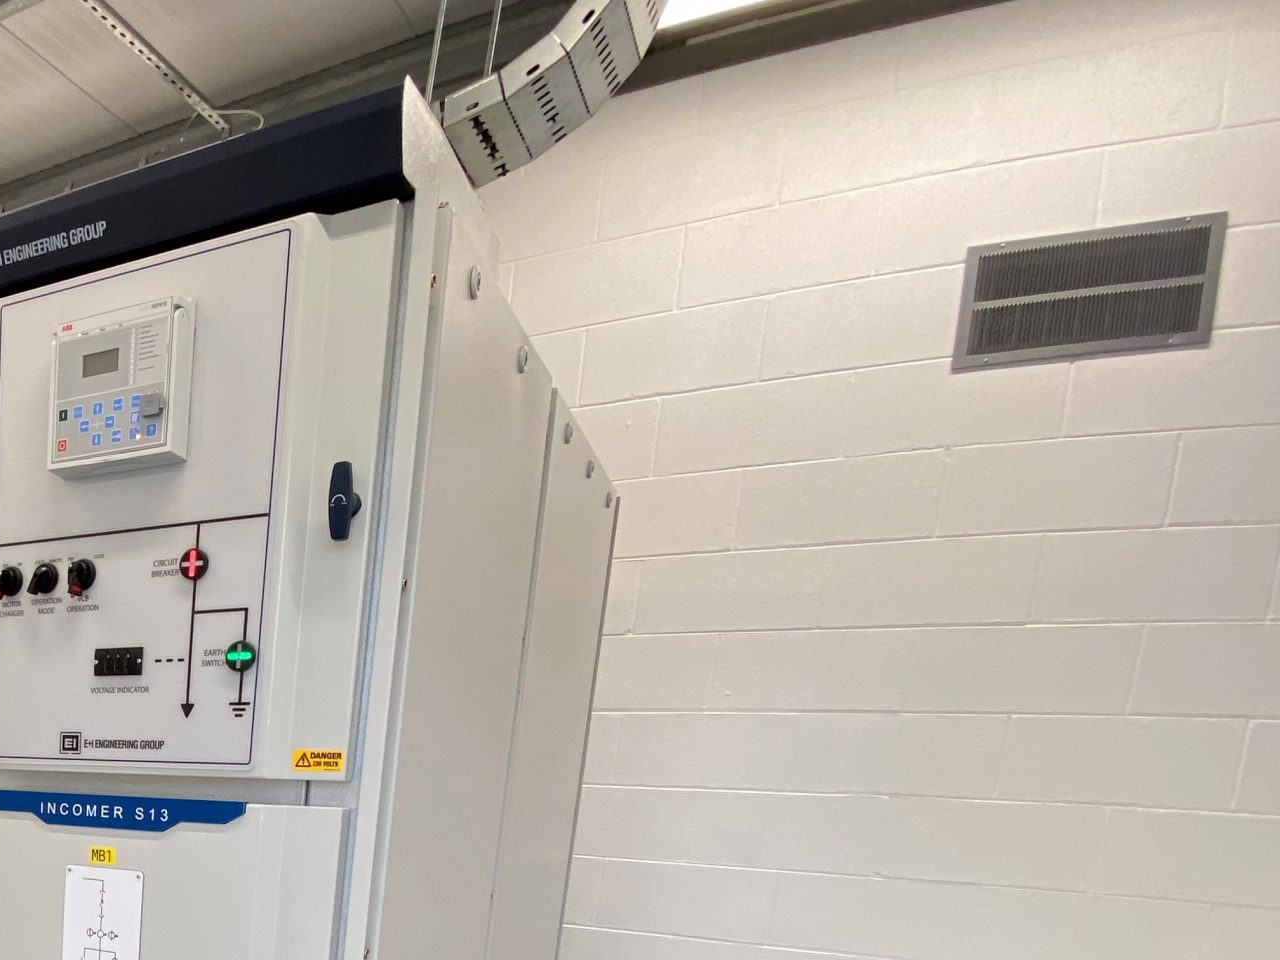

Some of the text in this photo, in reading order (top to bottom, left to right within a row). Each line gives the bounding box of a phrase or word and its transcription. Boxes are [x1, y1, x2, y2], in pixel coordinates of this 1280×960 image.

[4, 232, 68, 265] ENGINEERING
[69, 220, 107, 245] GROUP
[153, 558, 178, 567] CIRCUIT
[151, 569, 180, 578] BREAKER
[2, 600, 22, 608] MOTOR
[31, 597, 62, 606] OPERATION
[38, 607, 55, 615] MODE
[66, 604, 99, 613] OPERATION
[0, 609, 24, 618] CHARGER
[90, 686, 150, 694] VOLTAGE INDICATOR
[95, 739, 139, 750] ENGINEERING
[140, 740, 165, 750] GROUP
[310, 752, 342, 760] DANGER
[40, 801, 169, 823] INCOMER S13
[91, 848, 113, 863] MB1
